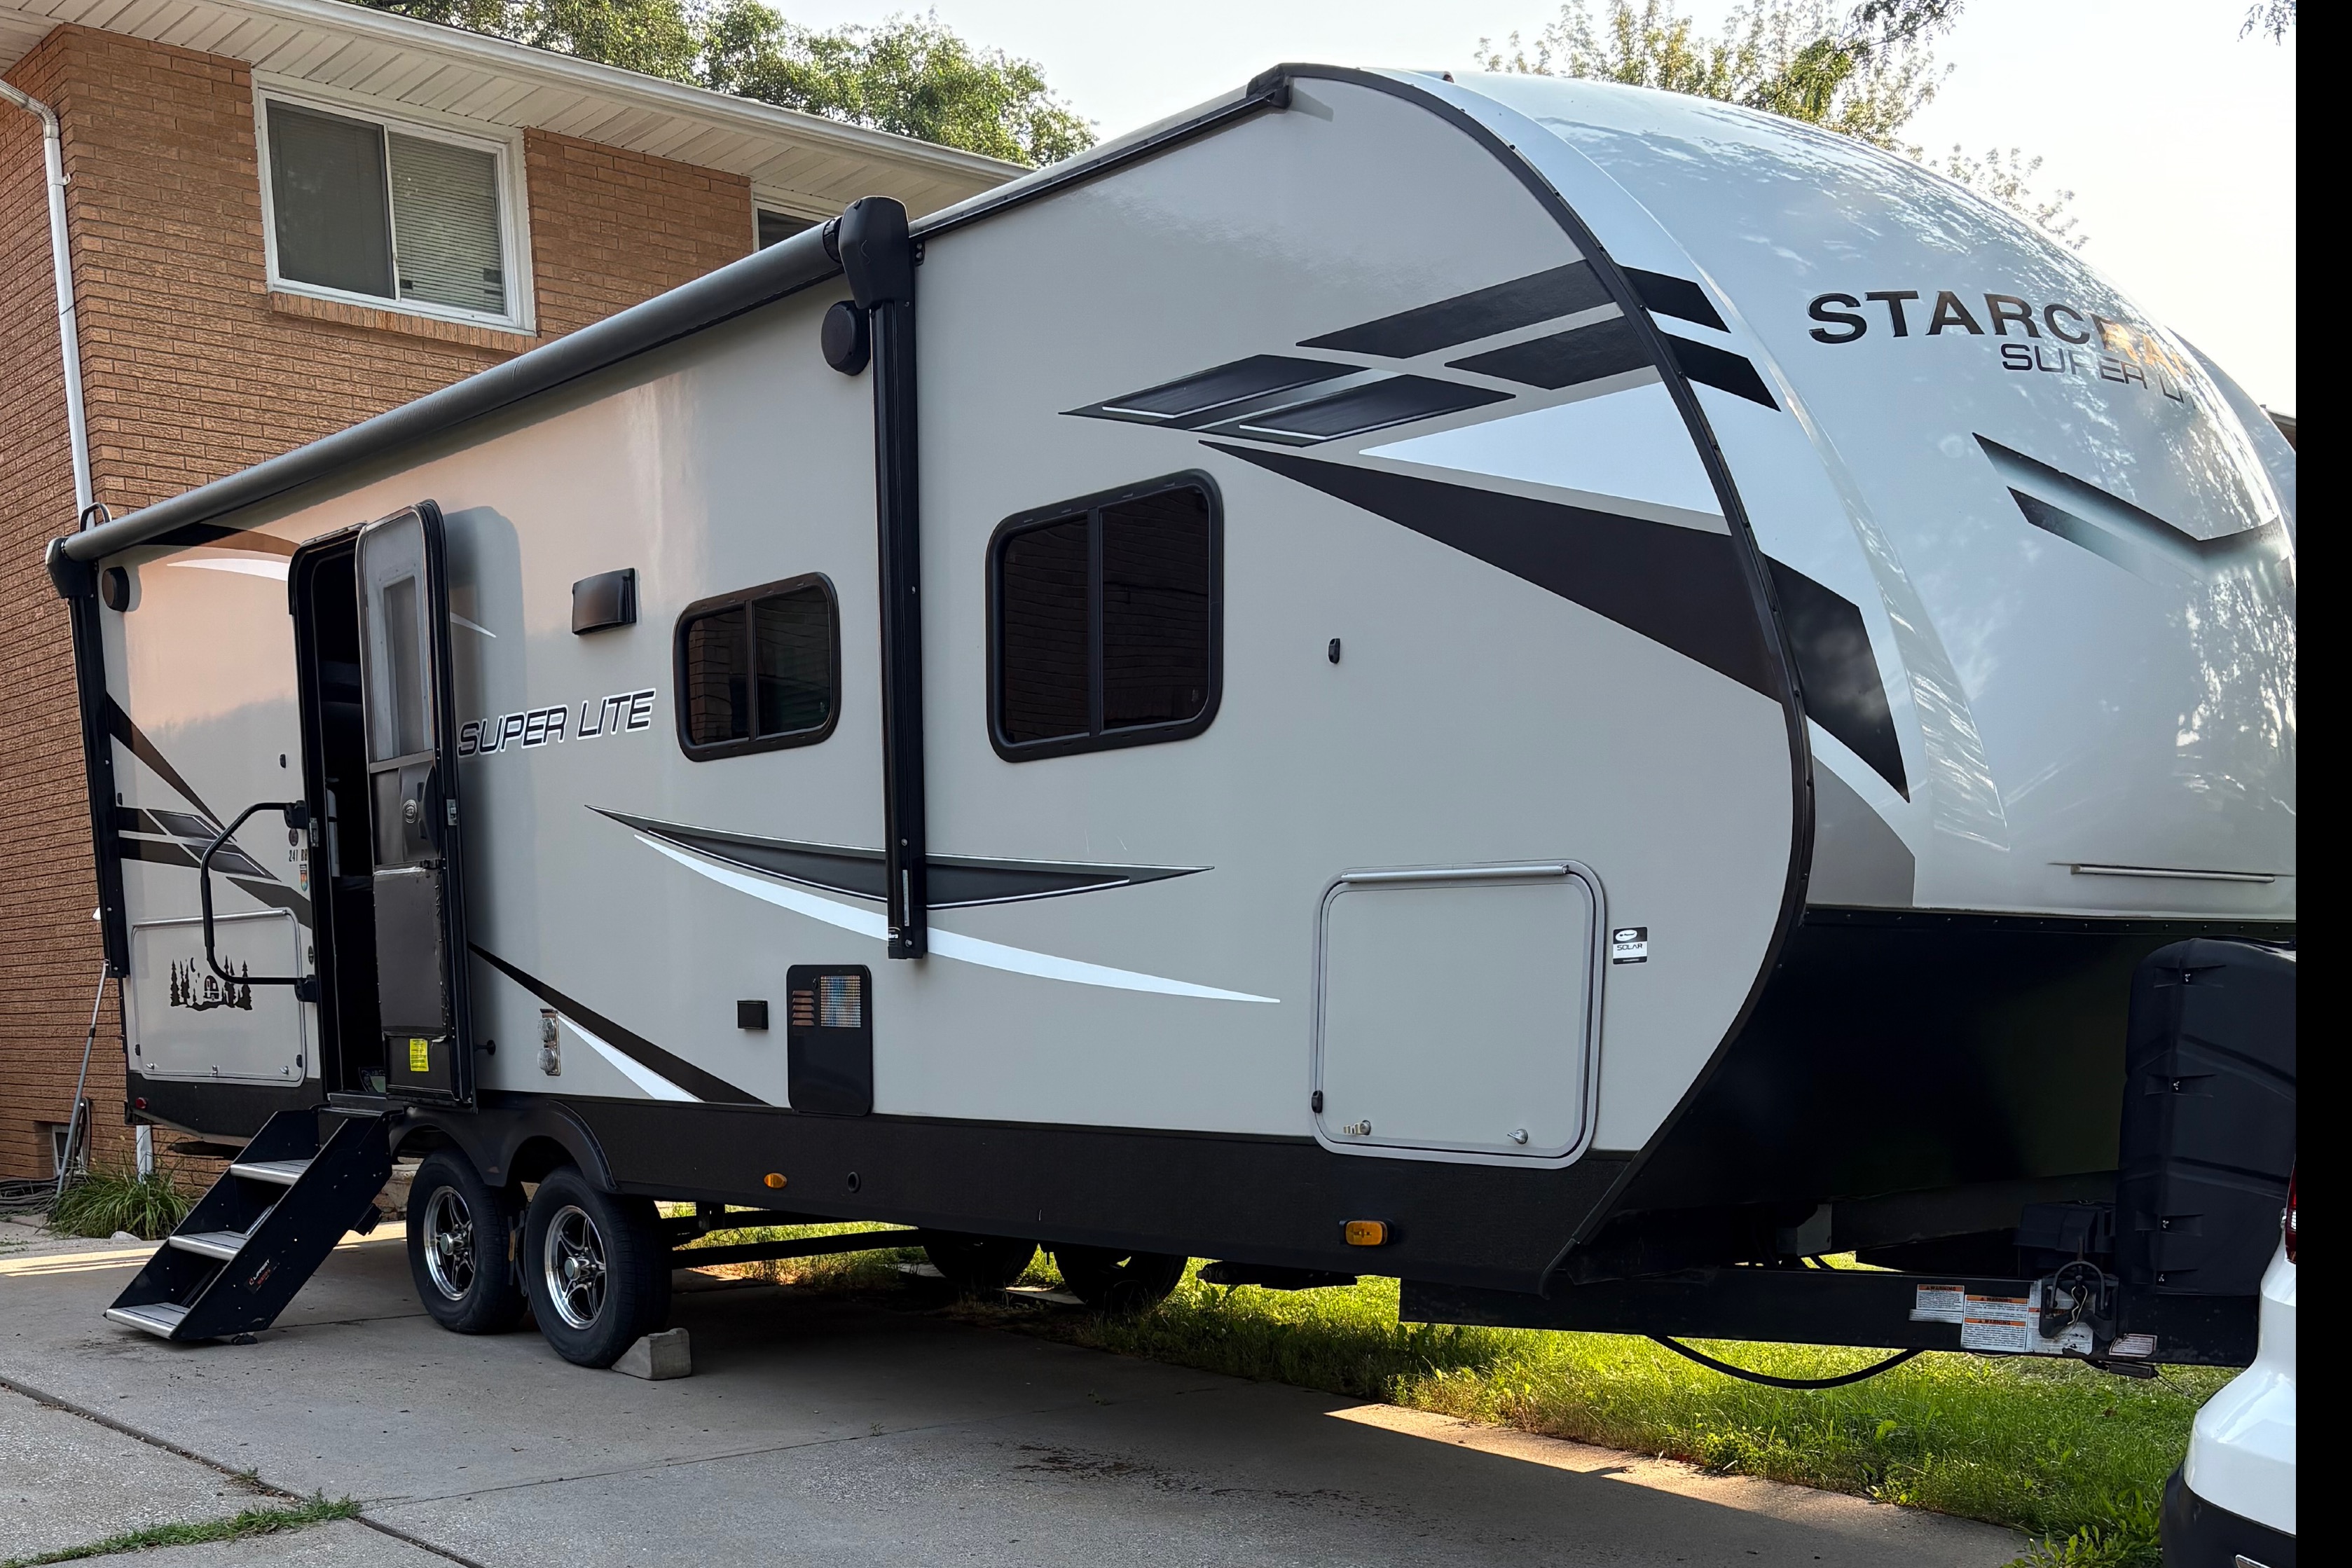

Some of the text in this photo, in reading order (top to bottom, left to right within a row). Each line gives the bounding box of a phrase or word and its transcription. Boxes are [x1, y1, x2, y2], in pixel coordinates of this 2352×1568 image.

[2000, 343, 2148, 390] SUPER
[458, 687, 656, 757] SUPER LITE
[289, 849, 298, 862] 241
